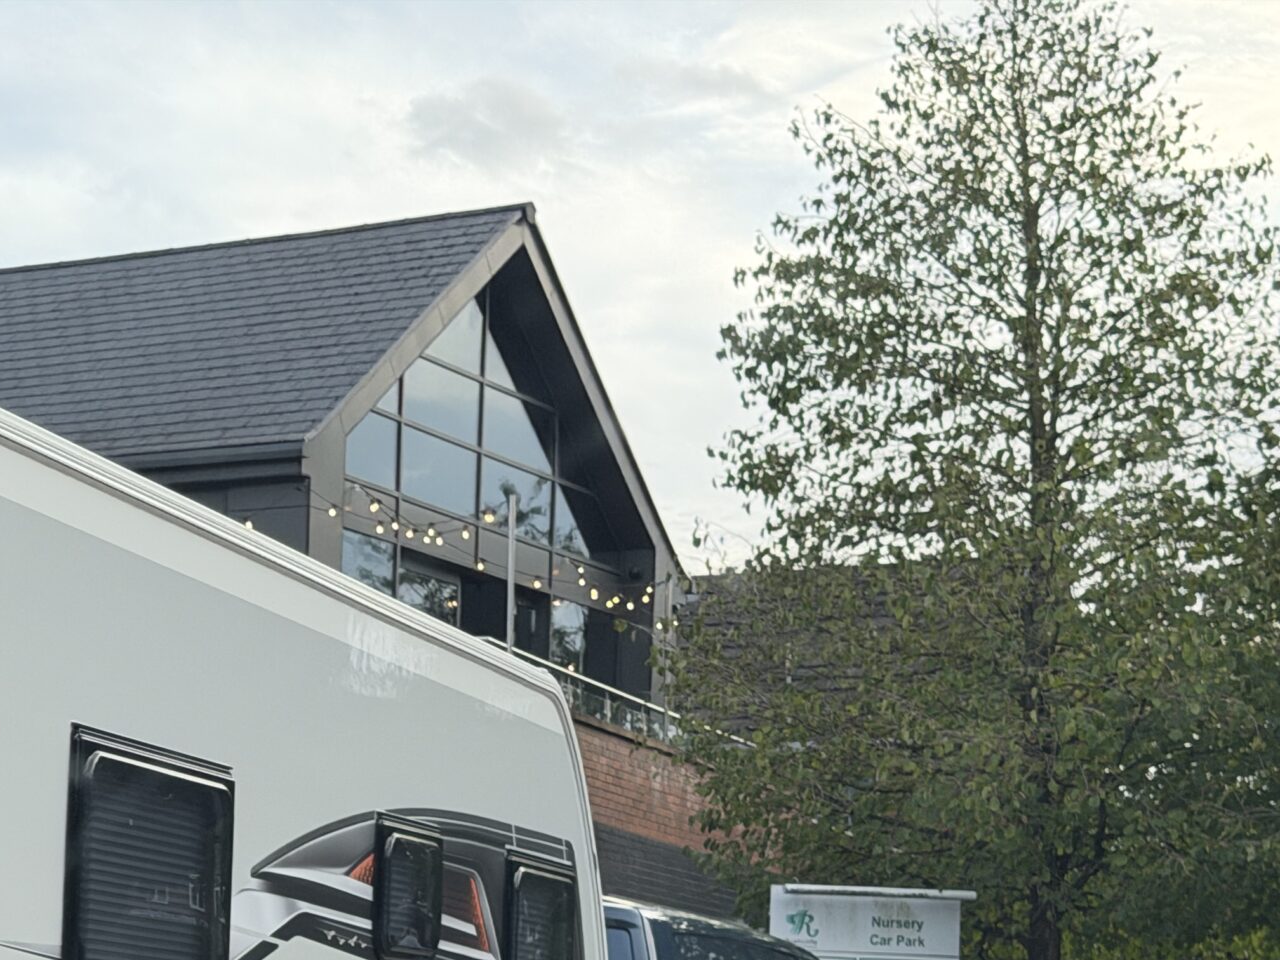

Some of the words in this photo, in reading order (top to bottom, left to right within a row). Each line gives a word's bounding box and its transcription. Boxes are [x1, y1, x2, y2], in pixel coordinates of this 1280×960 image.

[871, 916, 924, 932] Nursery
[870, 934, 893, 946] Car
[896, 935, 926, 947] Park
